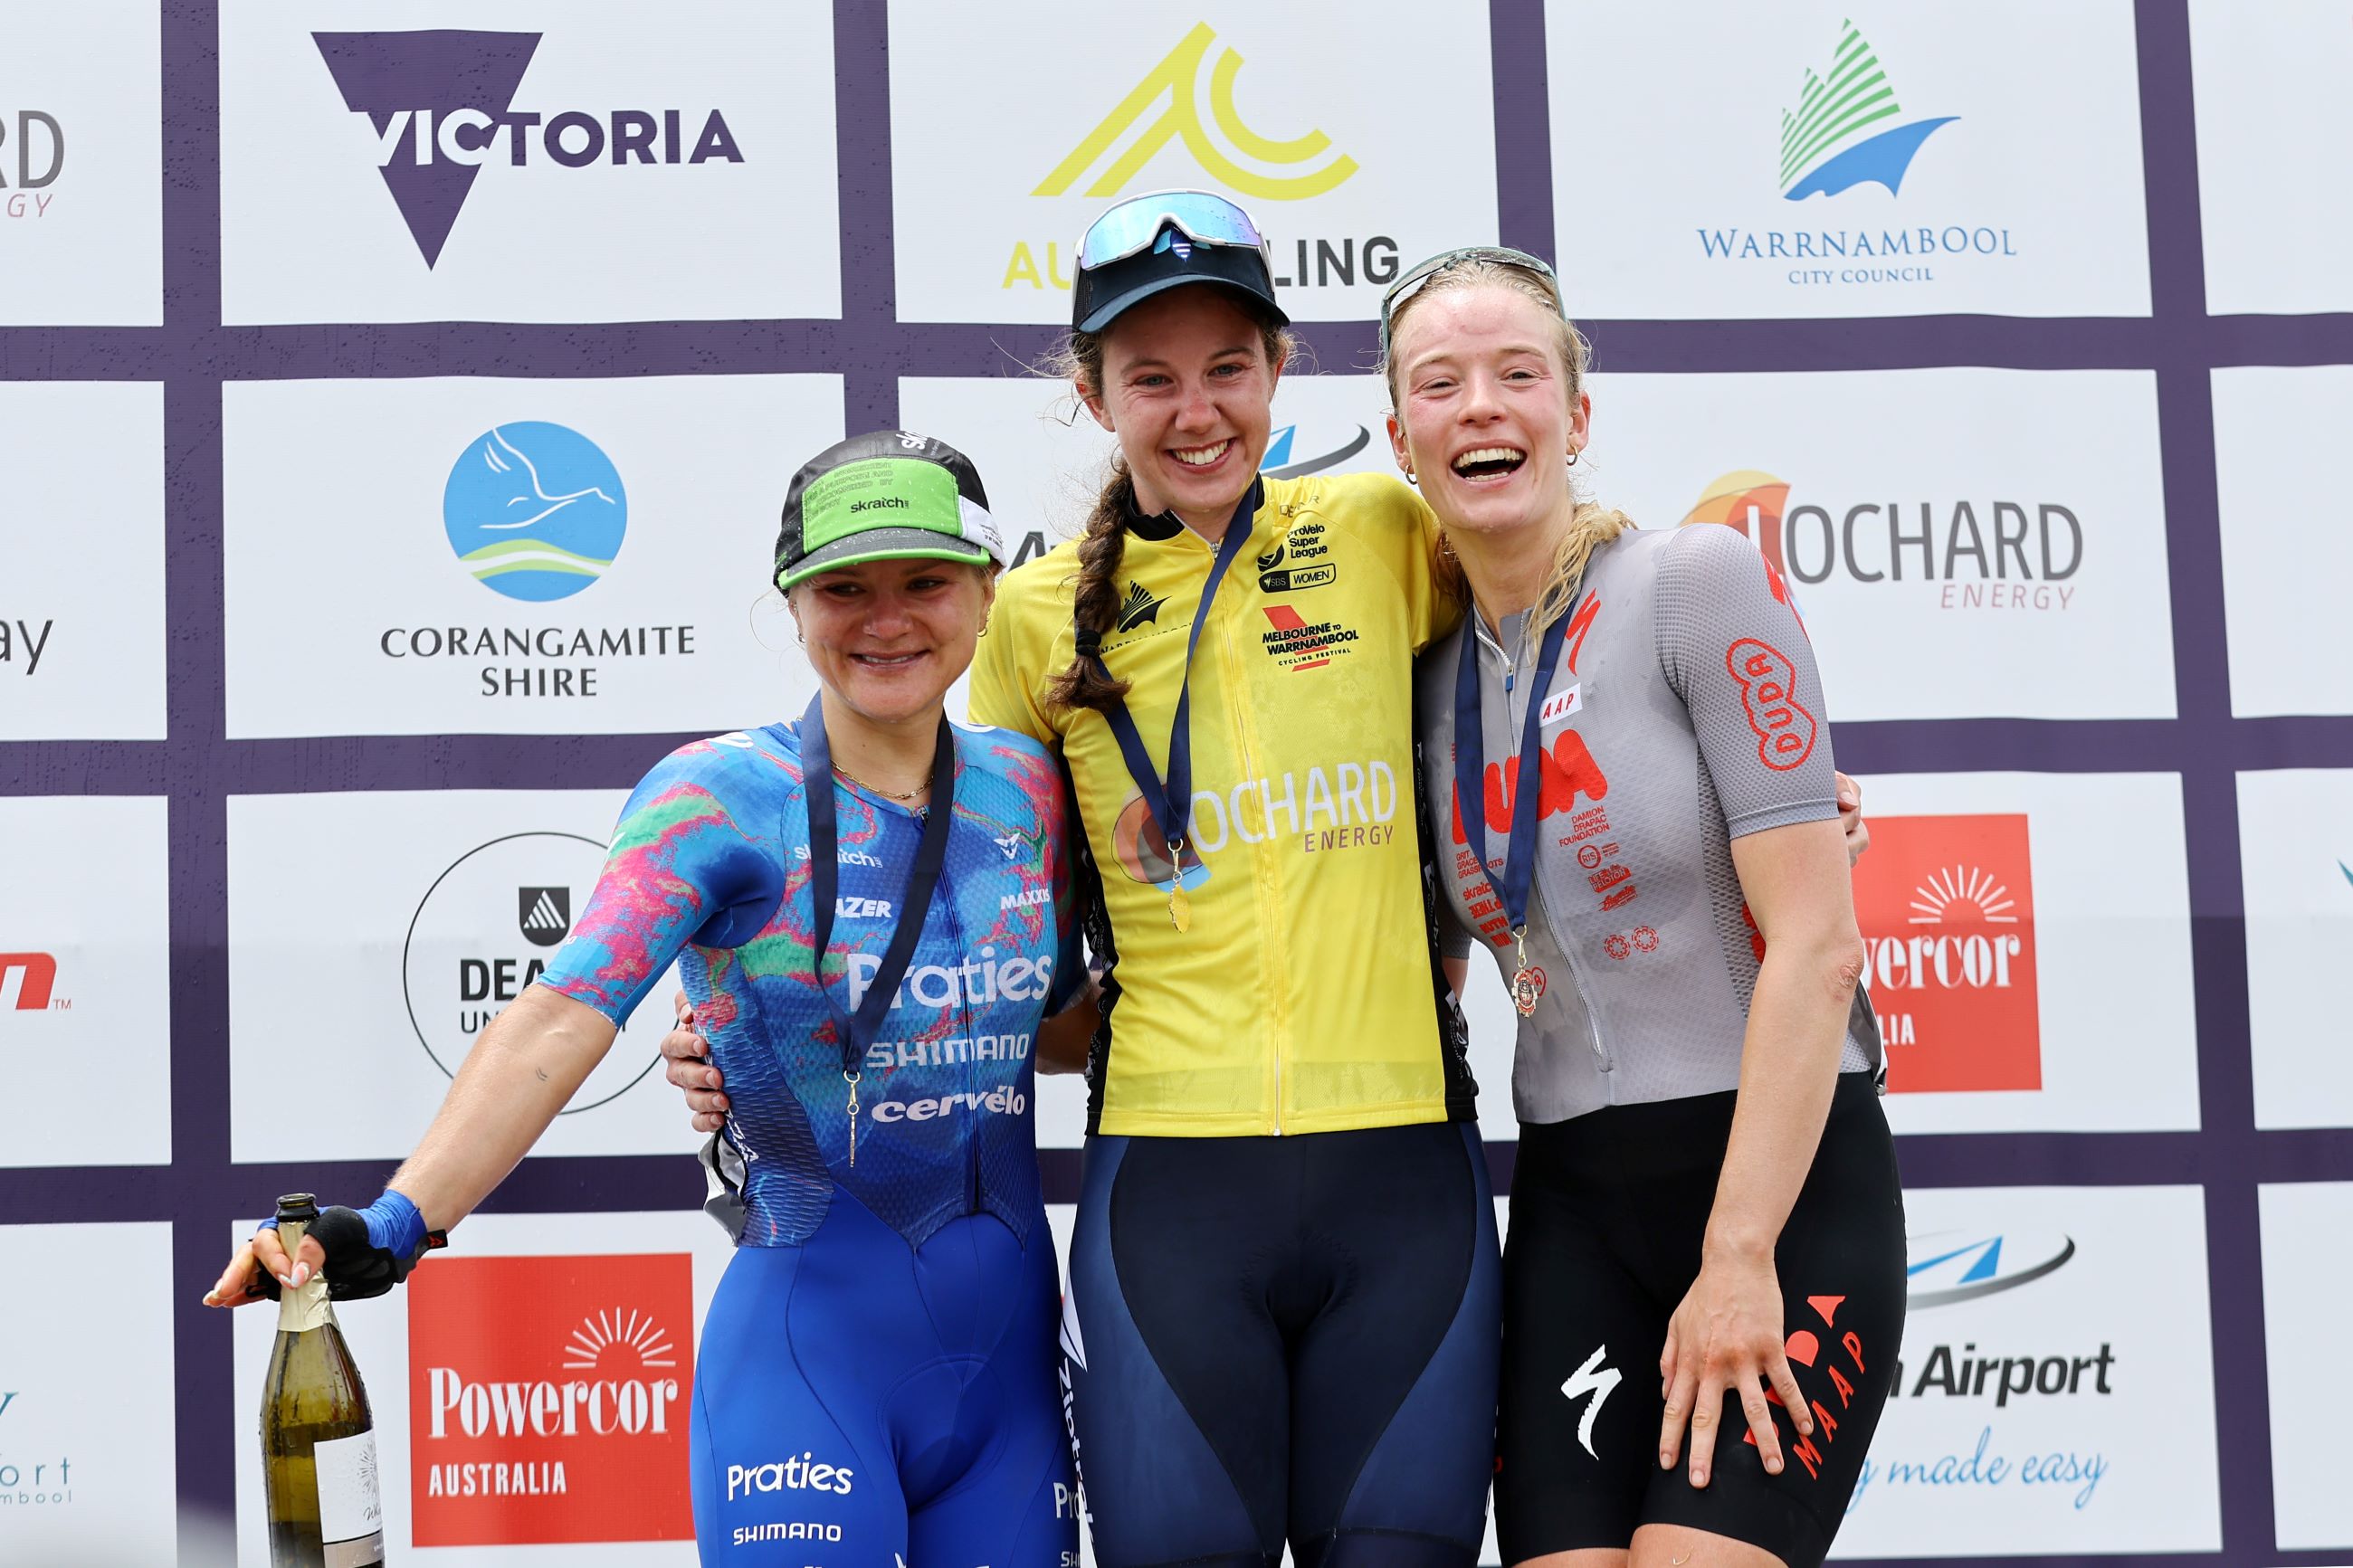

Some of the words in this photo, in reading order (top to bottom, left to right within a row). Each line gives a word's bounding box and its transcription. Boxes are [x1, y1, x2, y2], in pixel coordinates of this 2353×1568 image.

[367, 108, 746, 168] VICTORIA
[1697, 225, 2017, 260] WARRNAMBOOL
[1788, 271, 1833, 285] CITY
[1841, 267, 1935, 283] COUNCIL
[850, 496, 905, 514] skratch
[1288, 536, 1320, 548] Super
[1291, 545, 1329, 559] League
[1748, 500, 2084, 584] LOCHARD
[1270, 577, 1287, 588] SBS
[1292, 569, 1330, 585] WOMEN
[1940, 584, 2076, 613] ENERGY
[380, 625, 695, 659] CORANGAMITE
[1262, 622, 1331, 645] MELBOURNE
[1332, 622, 1342, 632] TO
[1266, 629, 1360, 657] WARRNAMBOOL
[1278, 656, 1312, 667] CYCLING
[1315, 648, 1351, 660] FESTIVAL
[481, 667, 598, 698] SHIRE
[1542, 691, 1575, 720] AAP
[1745, 652, 1803, 754] DUDA
[1189, 760, 1396, 853] OCHARD
[1571, 805, 1605, 823] DAMION
[1558, 822, 1610, 848] FOUNDATION
[1573, 814, 1607, 833] DRAPAC
[1303, 824, 1394, 854] ENERGY
[1455, 850, 1471, 861] GRIT
[1581, 851, 1597, 863] RIS
[835, 897, 892, 918] AZER
[1000, 888, 1051, 910] MAXXIS
[846, 946, 1053, 1012] Praties
[866, 1033, 1030, 1068] SHIMANO
[872, 1086, 1025, 1123] cervélo
[1910, 1343, 2116, 1408] Airport
[428, 1366, 678, 1440] Powercor
[428, 1460, 567, 1497] AUSTRALIA
[728, 1452, 853, 1501] Praties
[1888, 1425, 2014, 1485] made
[2021, 1452, 2110, 1510] easy
[733, 1523, 843, 1545] SHIMANO
